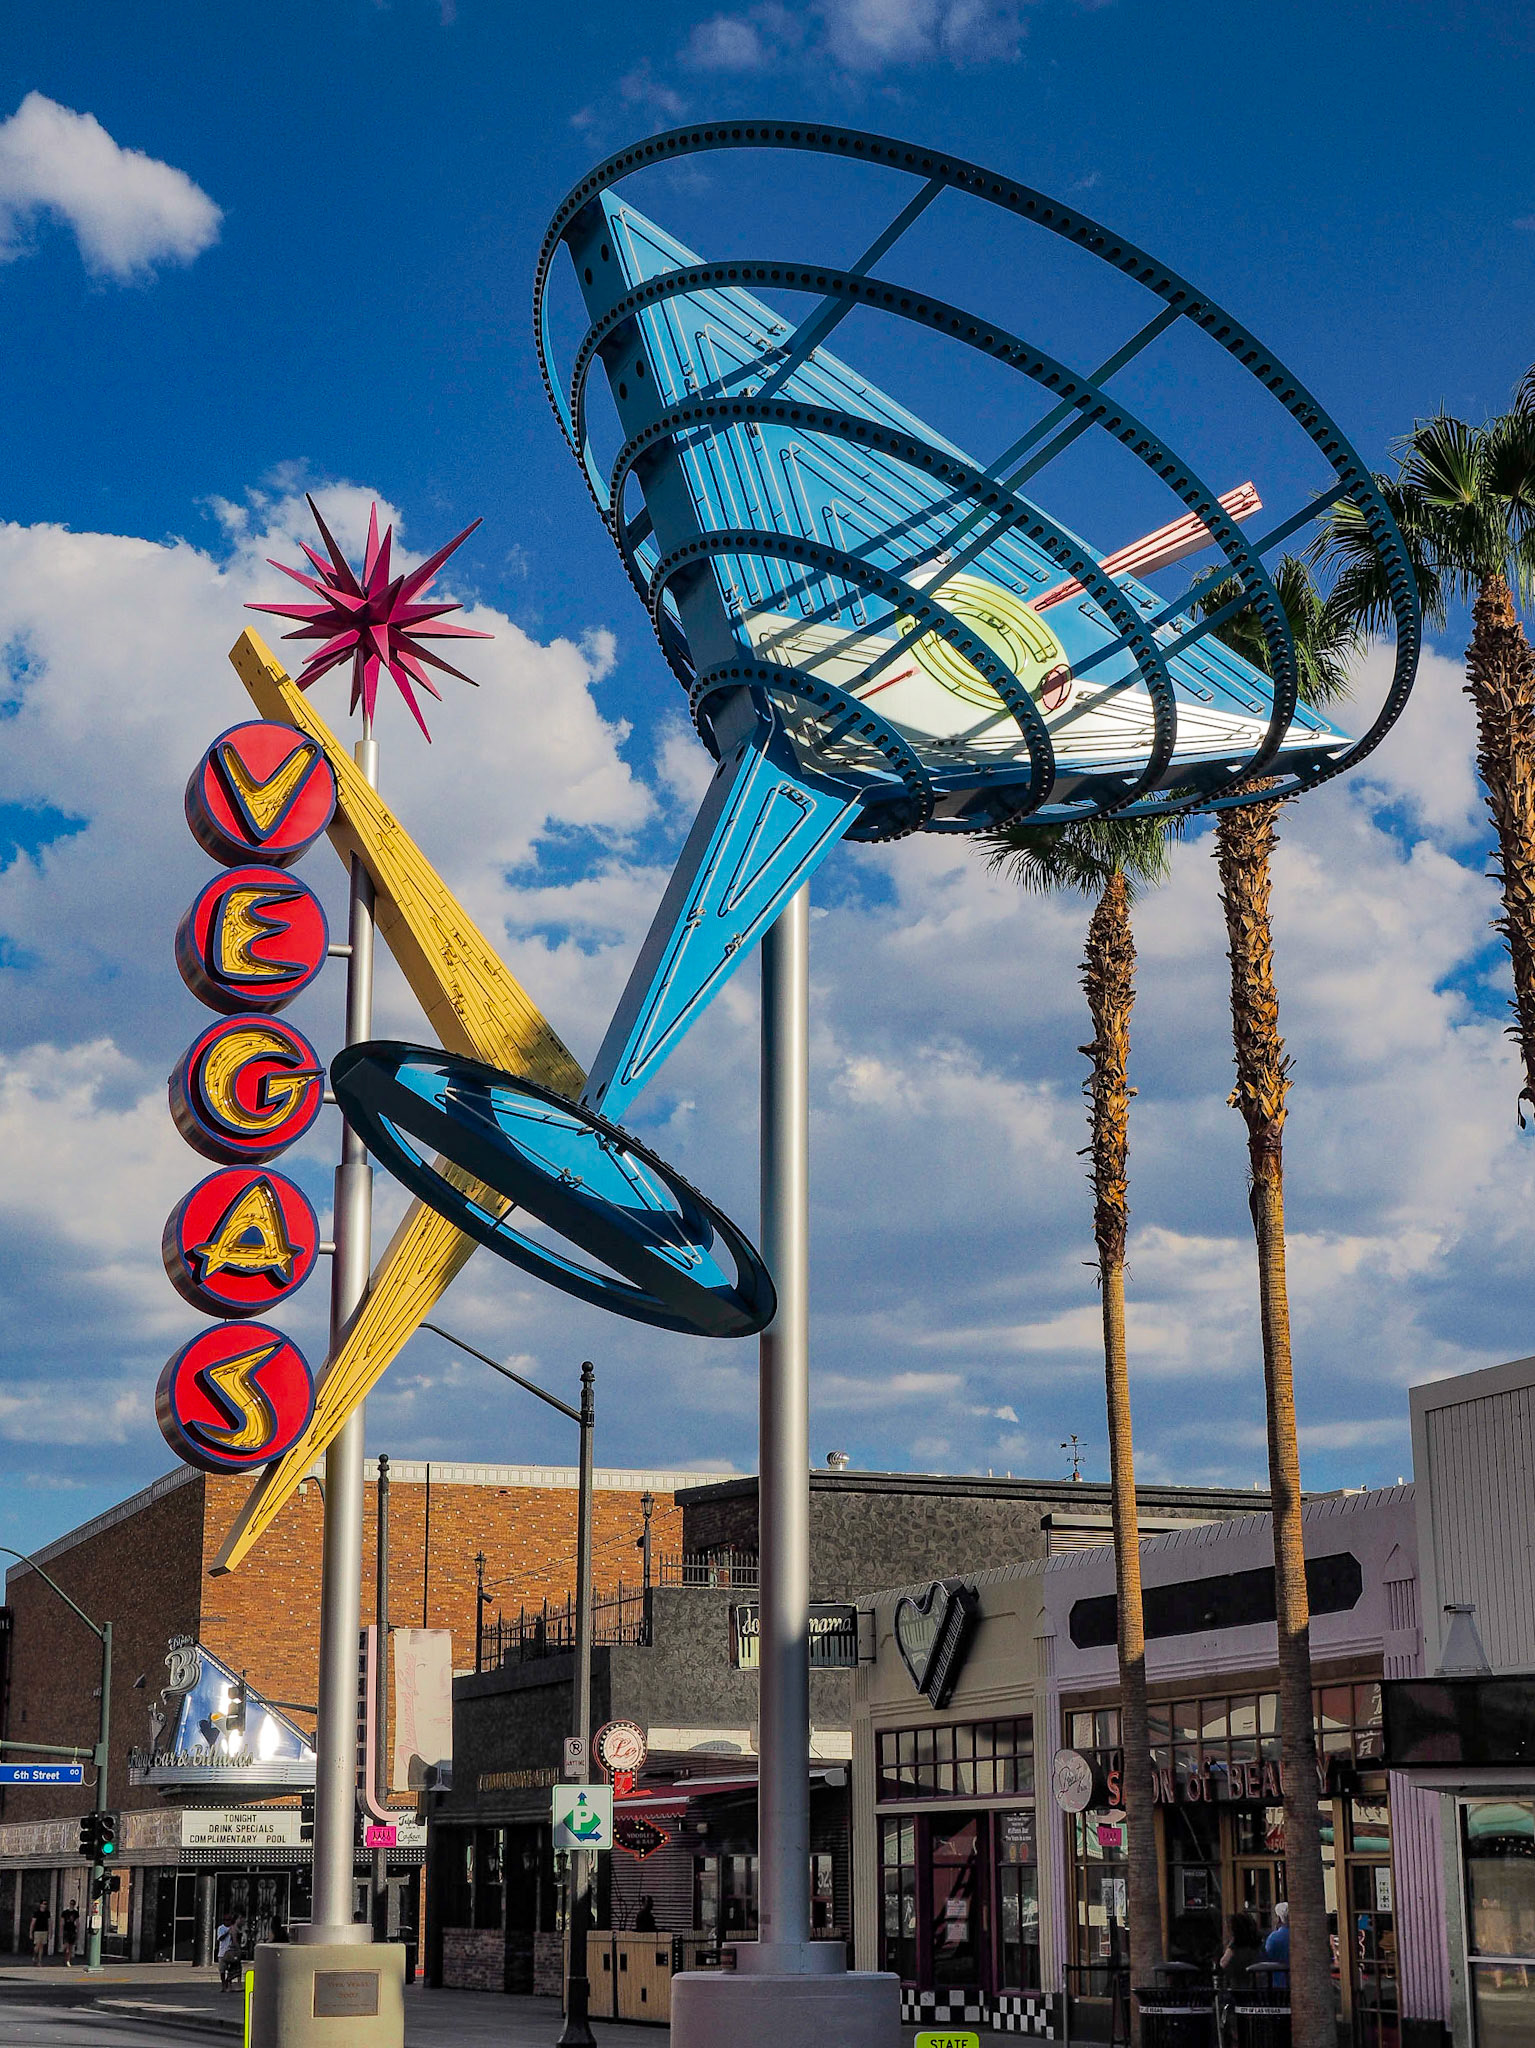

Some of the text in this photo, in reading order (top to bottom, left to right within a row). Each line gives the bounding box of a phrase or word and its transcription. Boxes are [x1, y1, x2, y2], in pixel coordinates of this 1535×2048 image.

[183, 741, 325, 1452] VEGAS
[13, 1770, 29, 1780] 6th
[32, 1770, 60, 1780] Street
[1227, 1752, 1332, 1798] BEAY
[224, 1813, 257, 1823] TONIGHT
[208, 1824, 274, 1833] DRINK SPECIALS
[189, 1834, 287, 1844] COMPLIMENTARY POOL
[930, 2039, 969, 2048] STATE
